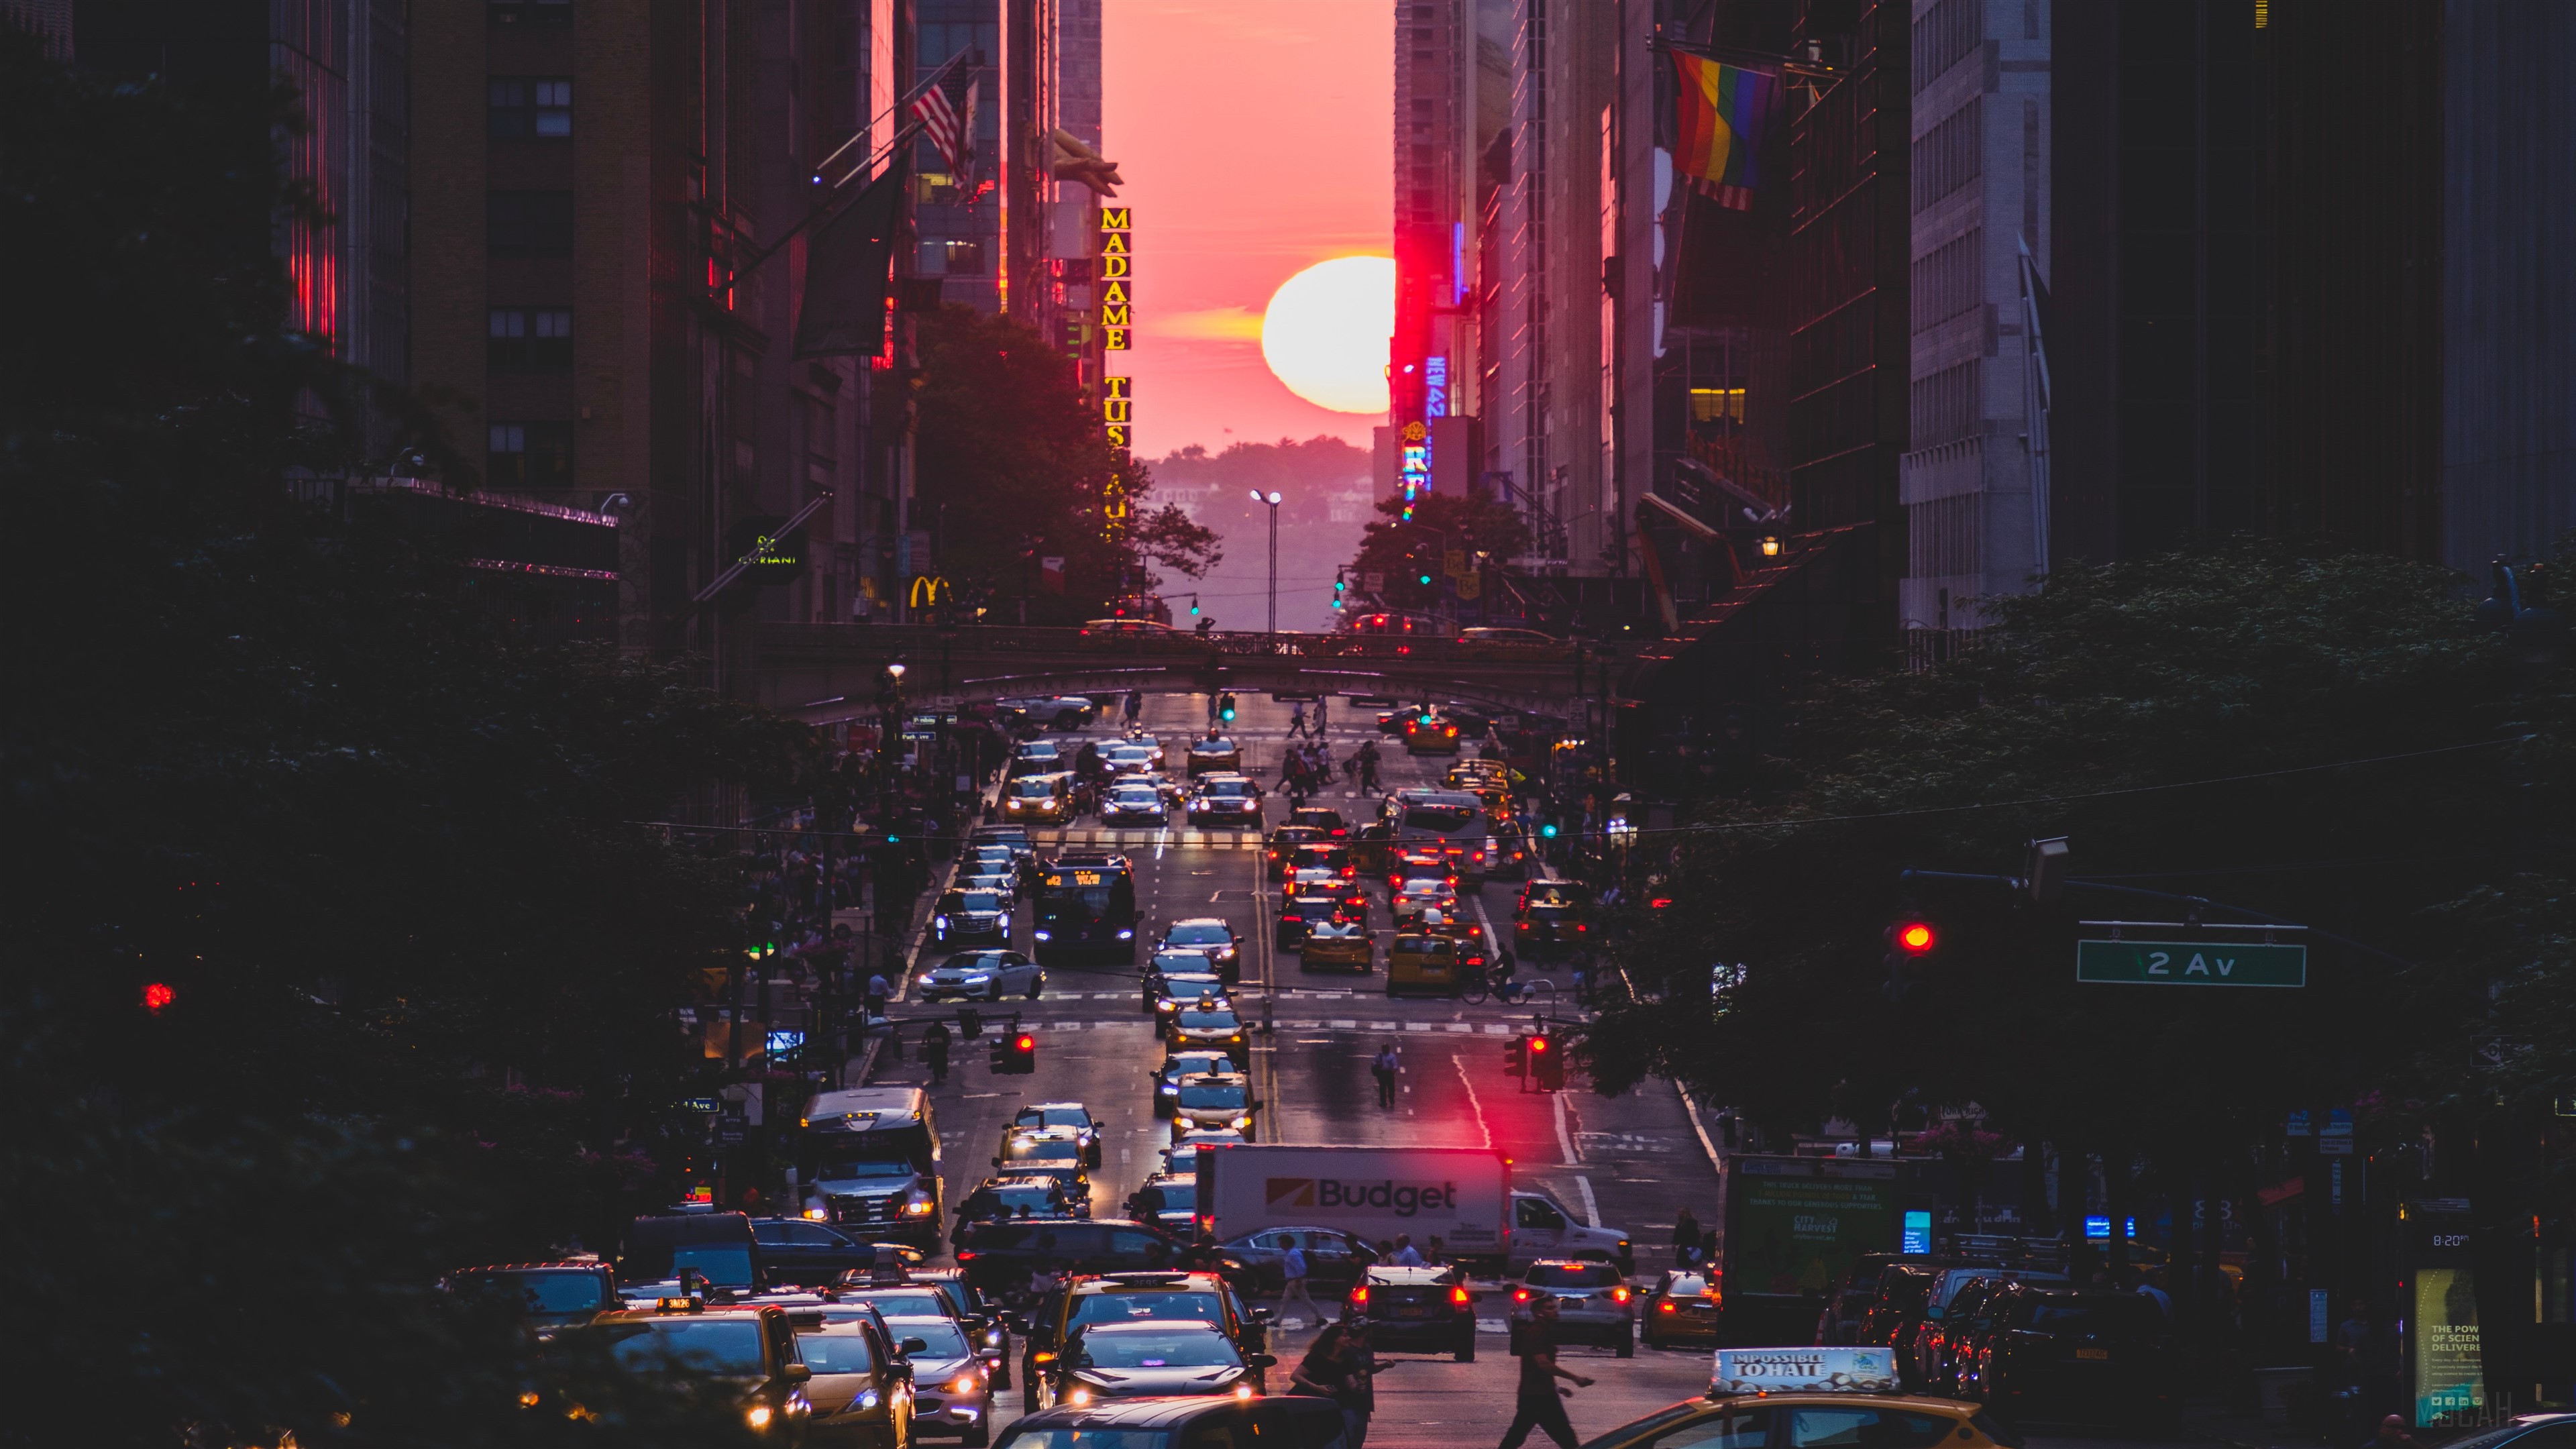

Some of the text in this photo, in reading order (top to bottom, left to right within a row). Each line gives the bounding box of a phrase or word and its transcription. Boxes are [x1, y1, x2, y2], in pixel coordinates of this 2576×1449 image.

[1101, 209, 1130, 350] MADAME
[1426, 357, 1446, 386] NEW
[987, 677, 1151, 696] SQUARE PLAZA
[1277, 678, 1352, 690] GRAND
[1570, 712, 1585, 721] 25
[2147, 951, 2236, 977] 2 Av
[692, 1101, 711, 1109] Ave
[1320, 1179, 1457, 1218] Budget
[1793, 1215, 1815, 1224] CITY
[1794, 1224, 1837, 1233] HARVEST
[2434, 1235, 2460, 1246] 8:20
[668, 1298, 690, 1309] 3M26
[1731, 1354, 1826, 1364] IMPOSSIBLE
[1734, 1363, 1826, 1377] TO HATE
